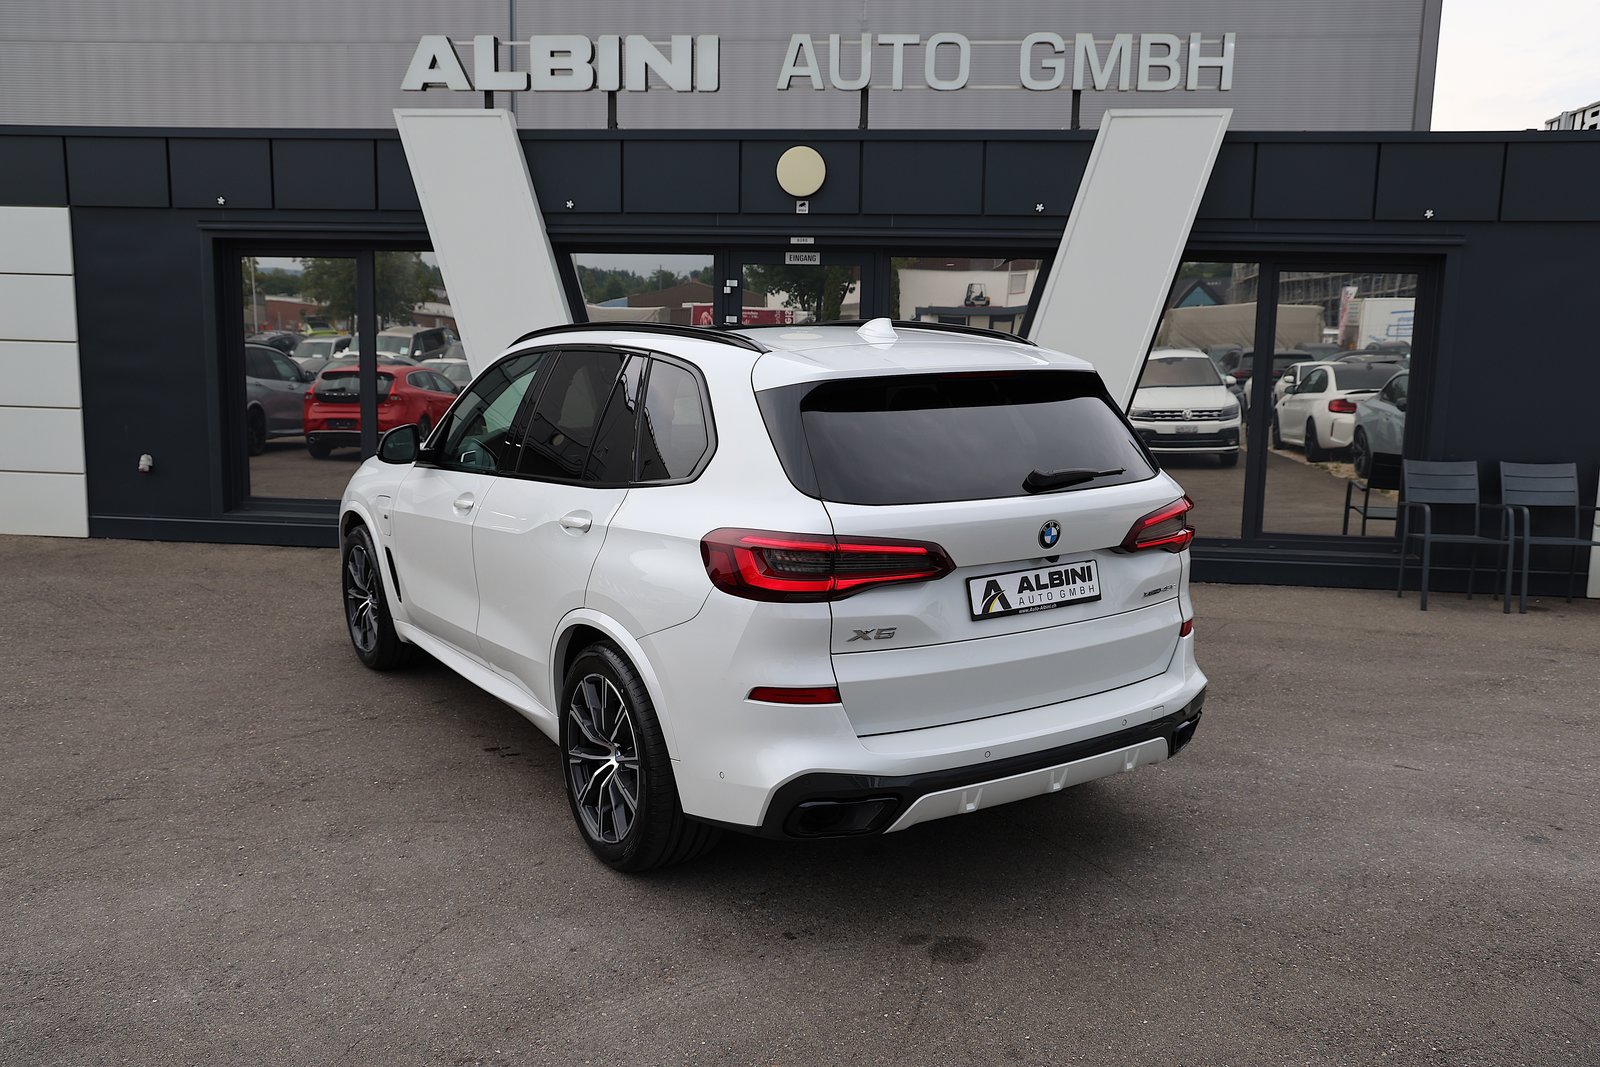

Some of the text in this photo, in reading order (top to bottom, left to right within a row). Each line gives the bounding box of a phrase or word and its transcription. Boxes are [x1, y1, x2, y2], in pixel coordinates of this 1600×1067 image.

[401, 32, 1237, 92] ALBINI AUTO GMBH
[789, 254, 817, 262] EINGANG
[1017, 565, 1093, 594] ALBINI
[1018, 584, 1095, 606] AUTO GMBH
[846, 626, 897, 642] X5
